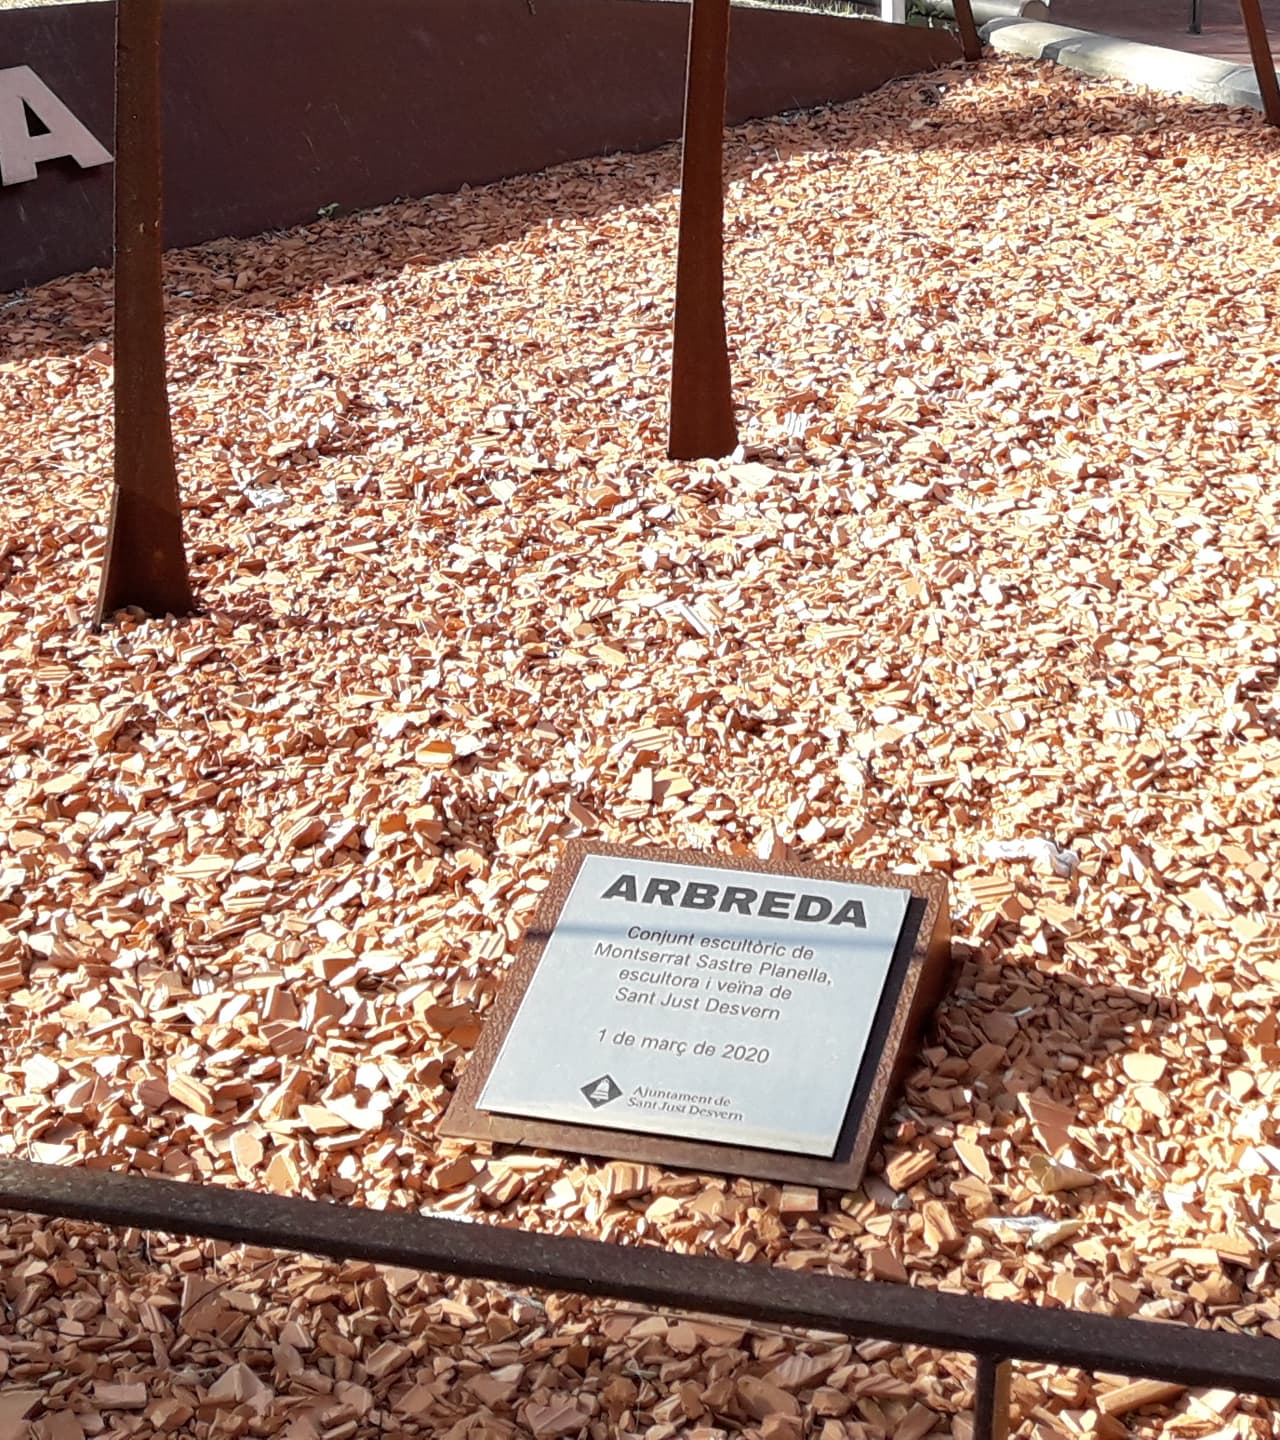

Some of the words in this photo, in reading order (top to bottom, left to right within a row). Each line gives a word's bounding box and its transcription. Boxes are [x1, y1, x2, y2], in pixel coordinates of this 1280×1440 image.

[601, 875, 867, 928] ARBREDA
[627, 926, 695, 946] Conjunt
[700, 935, 787, 958] escultòric
[792, 945, 814, 960] de
[594, 943, 691, 966] Montserrat
[696, 955, 753, 974] Sastre
[759, 962, 832, 985] Planella,
[619, 968, 700, 988] escultora
[705, 977, 712, 990] i
[718, 980, 763, 997] veïna
[770, 985, 792, 1000] de
[615, 987, 656, 1005] Sant
[660, 993, 700, 1010] Just
[706, 998, 780, 1020] Desvern
[598, 1028, 607, 1042] 1
[613, 1031, 635, 1046] de
[641, 1036, 687, 1056] març
[693, 1041, 716, 1056] de
[721, 1044, 770, 1063] 2020
[627, 1097, 657, 1110] Sant
[658, 1101, 687, 1113] Just
[689, 1105, 743, 1120] Desvern
[633, 1086, 714, 1104] Ajuntament
[714, 1096, 731, 1107] de
